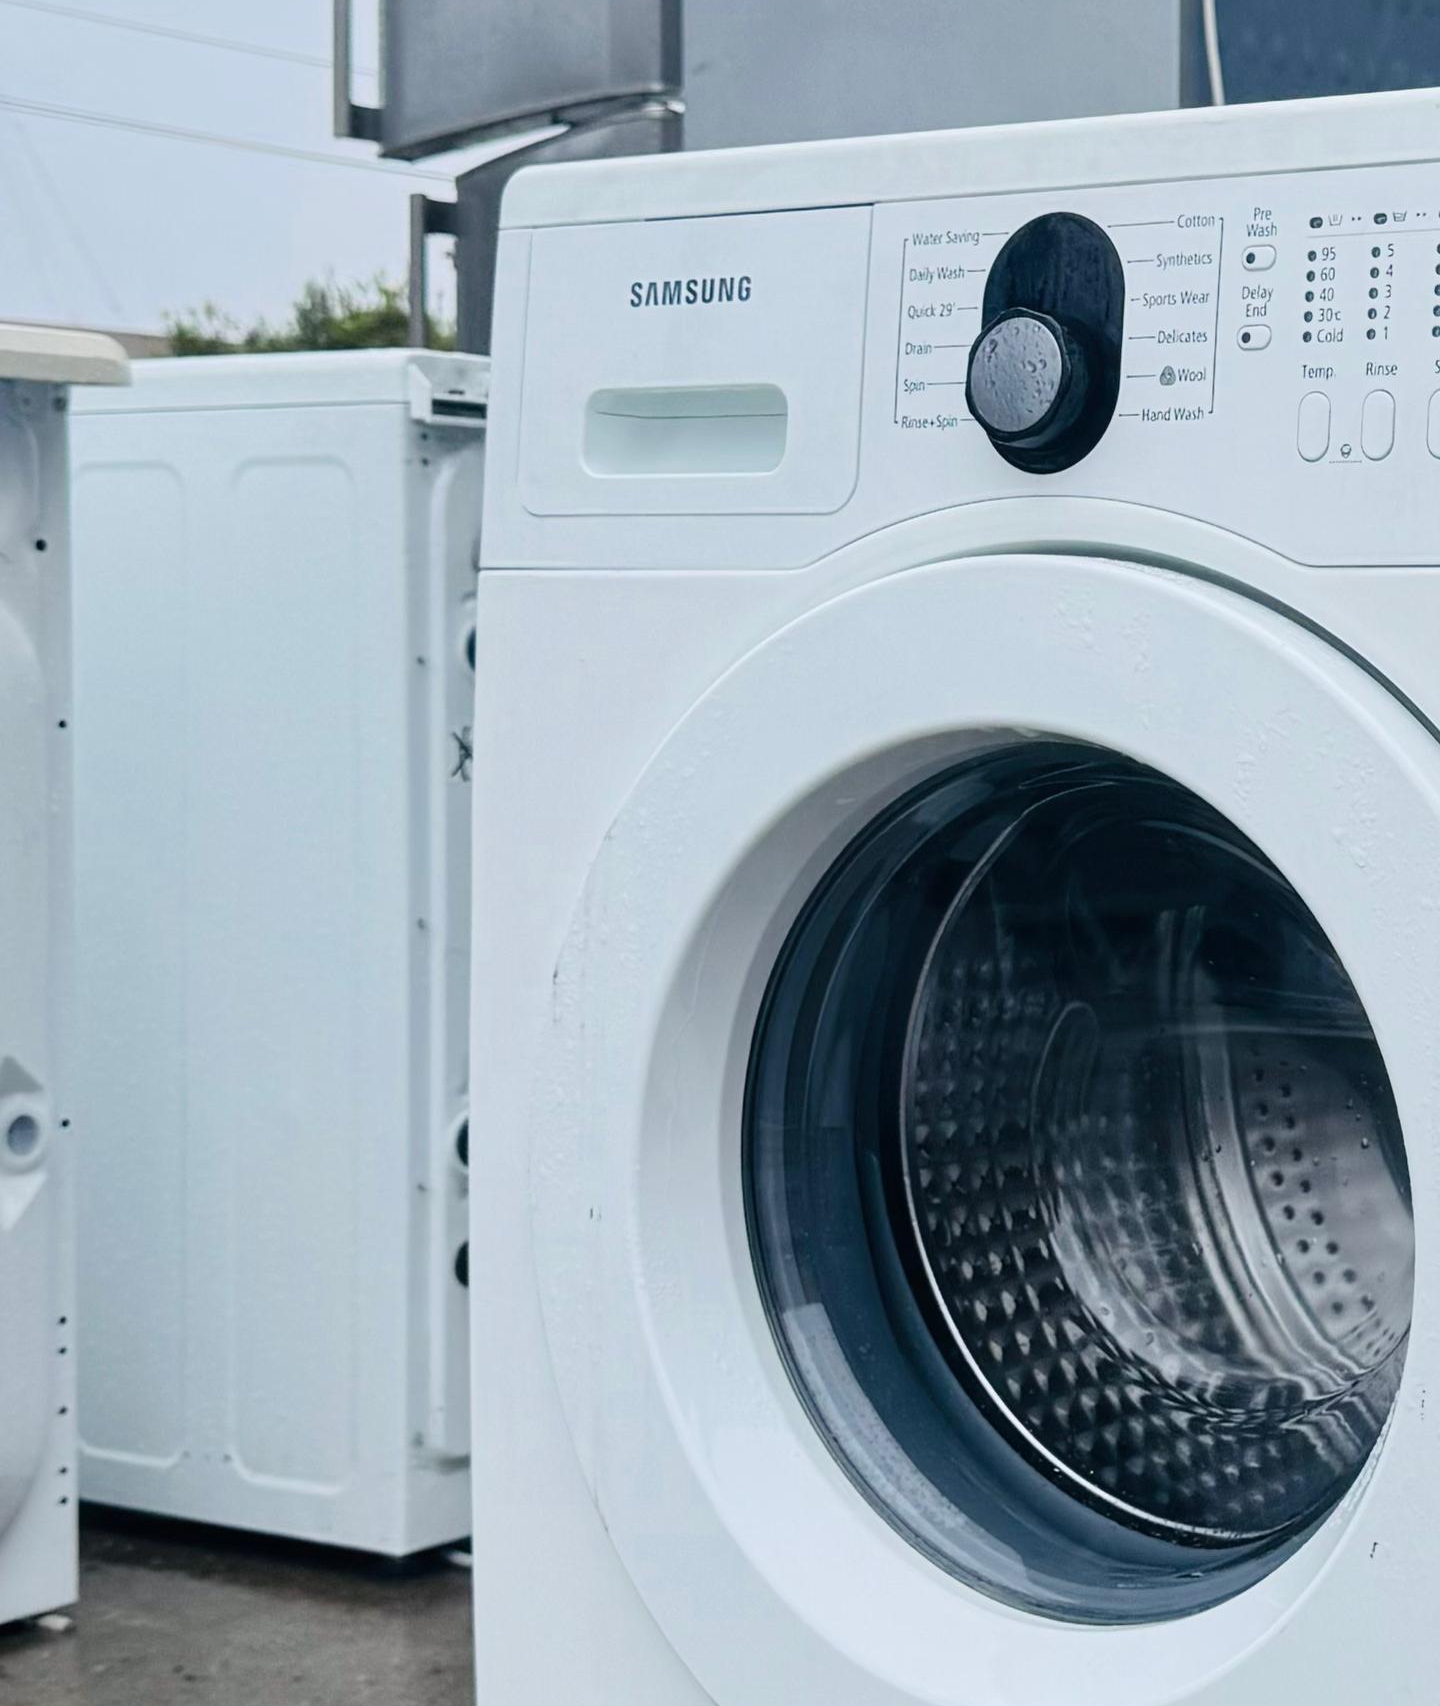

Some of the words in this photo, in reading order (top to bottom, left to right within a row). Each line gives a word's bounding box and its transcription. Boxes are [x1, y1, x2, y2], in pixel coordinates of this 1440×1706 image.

[1254, 207, 1272, 221] Pre
[1177, 214, 1215, 229] Cotton
[1246, 223, 1278, 237] Wash
[912, 233, 942, 245] Water
[946, 230, 980, 245] Saving
[1321, 247, 1336, 261] 95
[1387, 243, 1394, 257] 5
[1156, 253, 1213, 271] Synthetics
[910, 268, 935, 283] Daily
[938, 268, 965, 280] Wash
[1320, 267, 1335, 281] 60
[1385, 264, 1393, 278] 4
[630, 276, 751, 308] SAMSUNG
[1242, 285, 1273, 302] Delay
[1319, 287, 1334, 302] 40
[1385, 284, 1392, 298] 3
[1142, 293, 1177, 309] Sports
[1181, 291, 1210, 305] Wear
[908, 306, 936, 318] Quick
[1246, 303, 1267, 317] End
[1383, 305, 1390, 319] 2
[1157, 330, 1208, 344] Delicates
[1317, 328, 1344, 343] Cold
[1383, 326, 1388, 340] 1
[905, 343, 932, 355] Drain
[1177, 367, 1206, 382] Wool
[1366, 362, 1398, 376] Rinse
[903, 379, 925, 396] Spin
[1142, 408, 1170, 422] Hand
[1173, 406, 1204, 421] Wash
